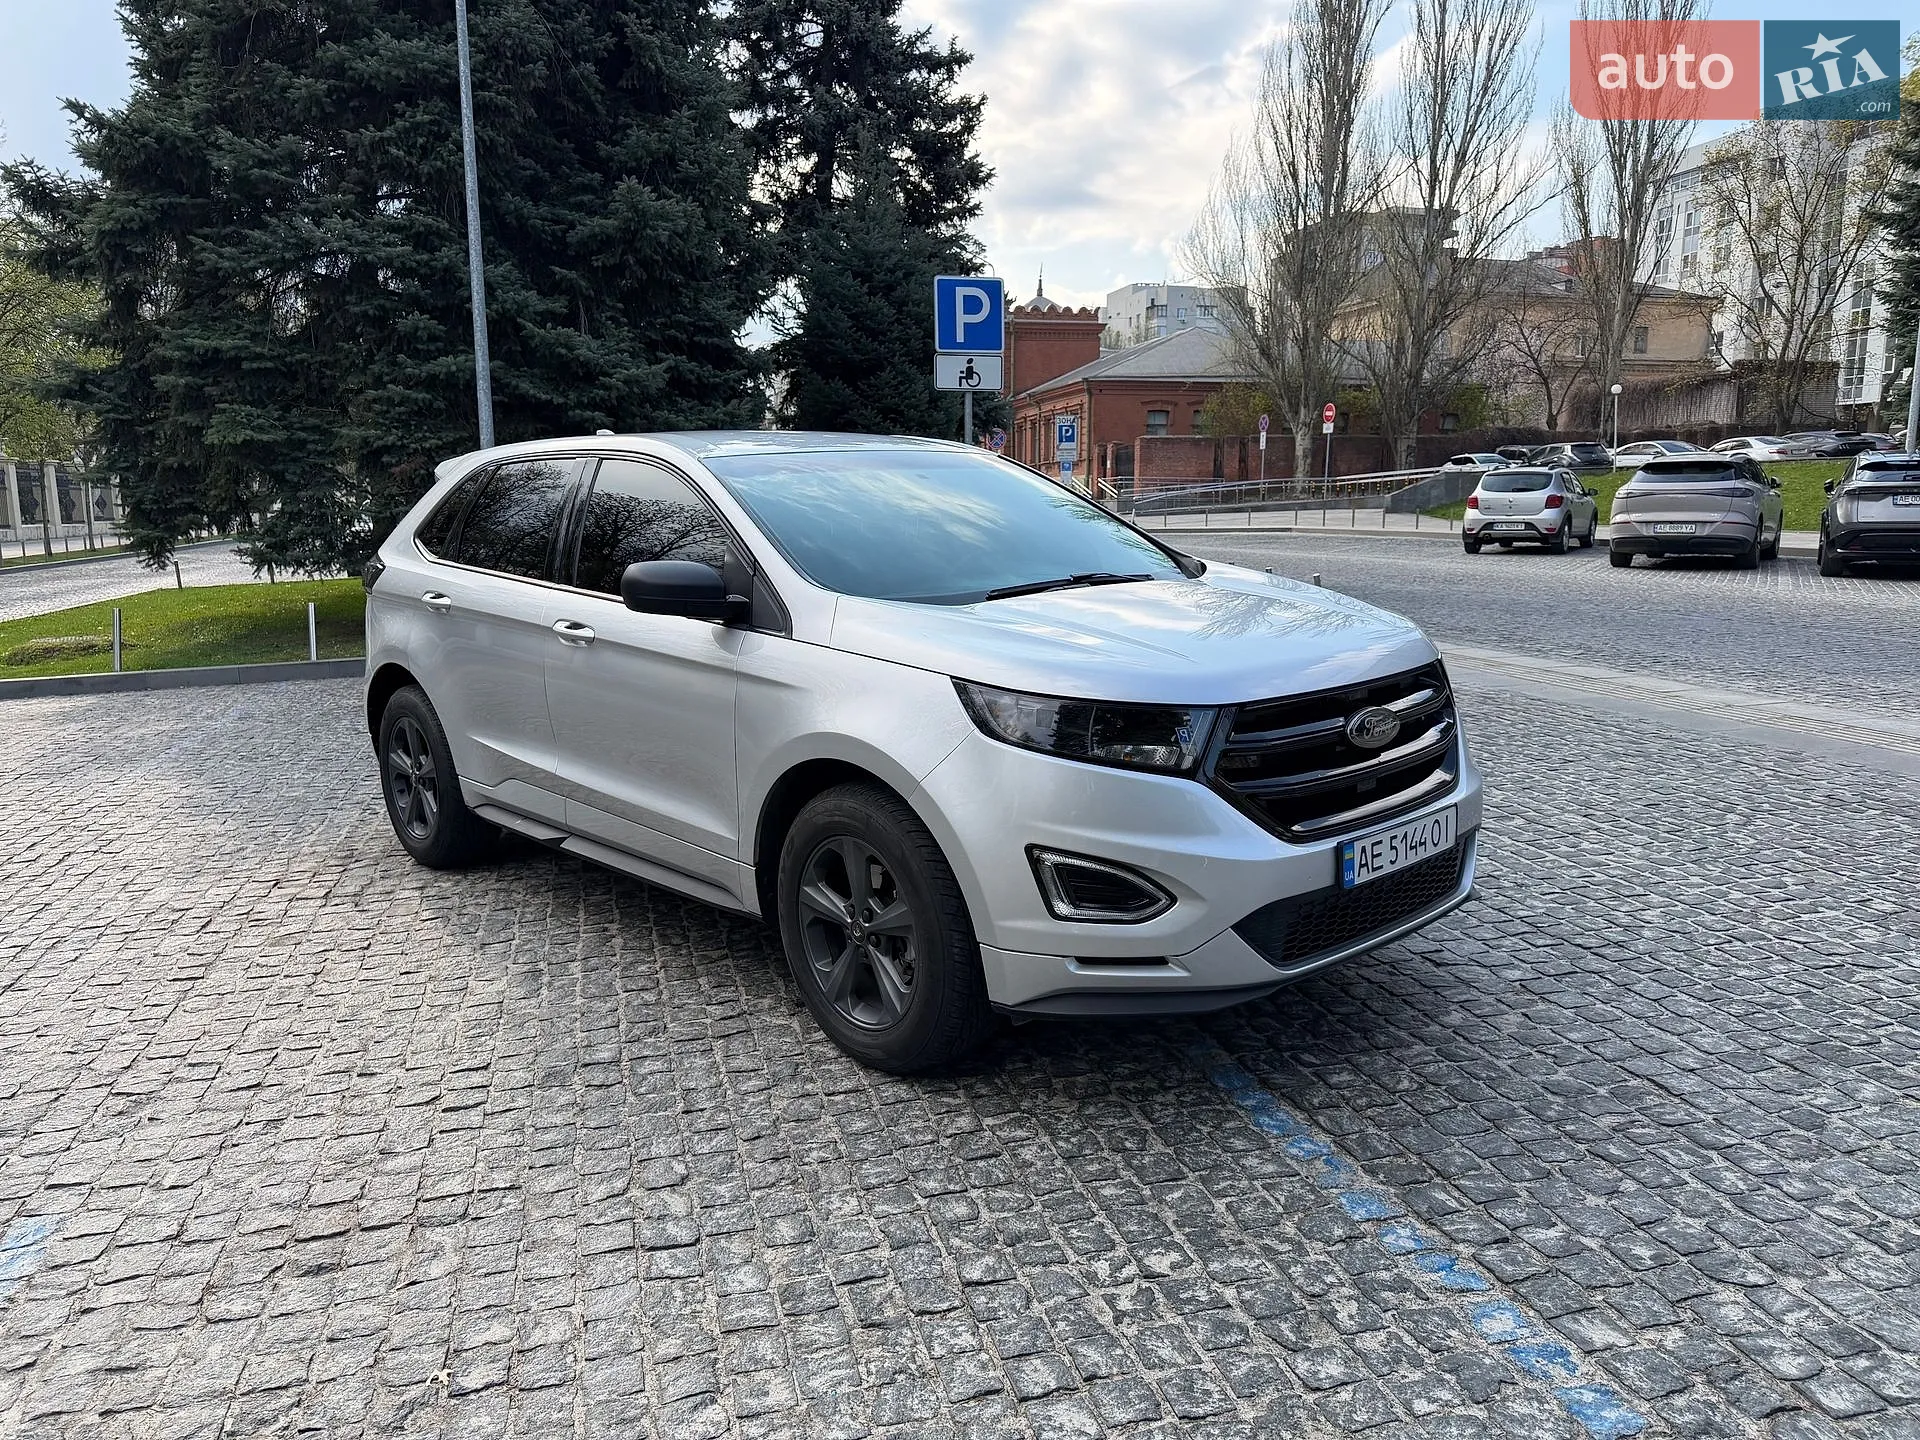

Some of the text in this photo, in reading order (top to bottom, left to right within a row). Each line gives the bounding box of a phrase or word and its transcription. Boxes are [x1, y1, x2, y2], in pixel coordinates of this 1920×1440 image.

[955, 286, 991, 343] P
[1057, 416, 1076, 425] ЗОНА
[1062, 426, 1073, 442] P
[1899, 495, 1910, 503] AE
[1364, 715, 1398, 740] Ford
[1357, 814, 1449, 878] AE 5144 OI
[1344, 870, 1355, 881] UA
